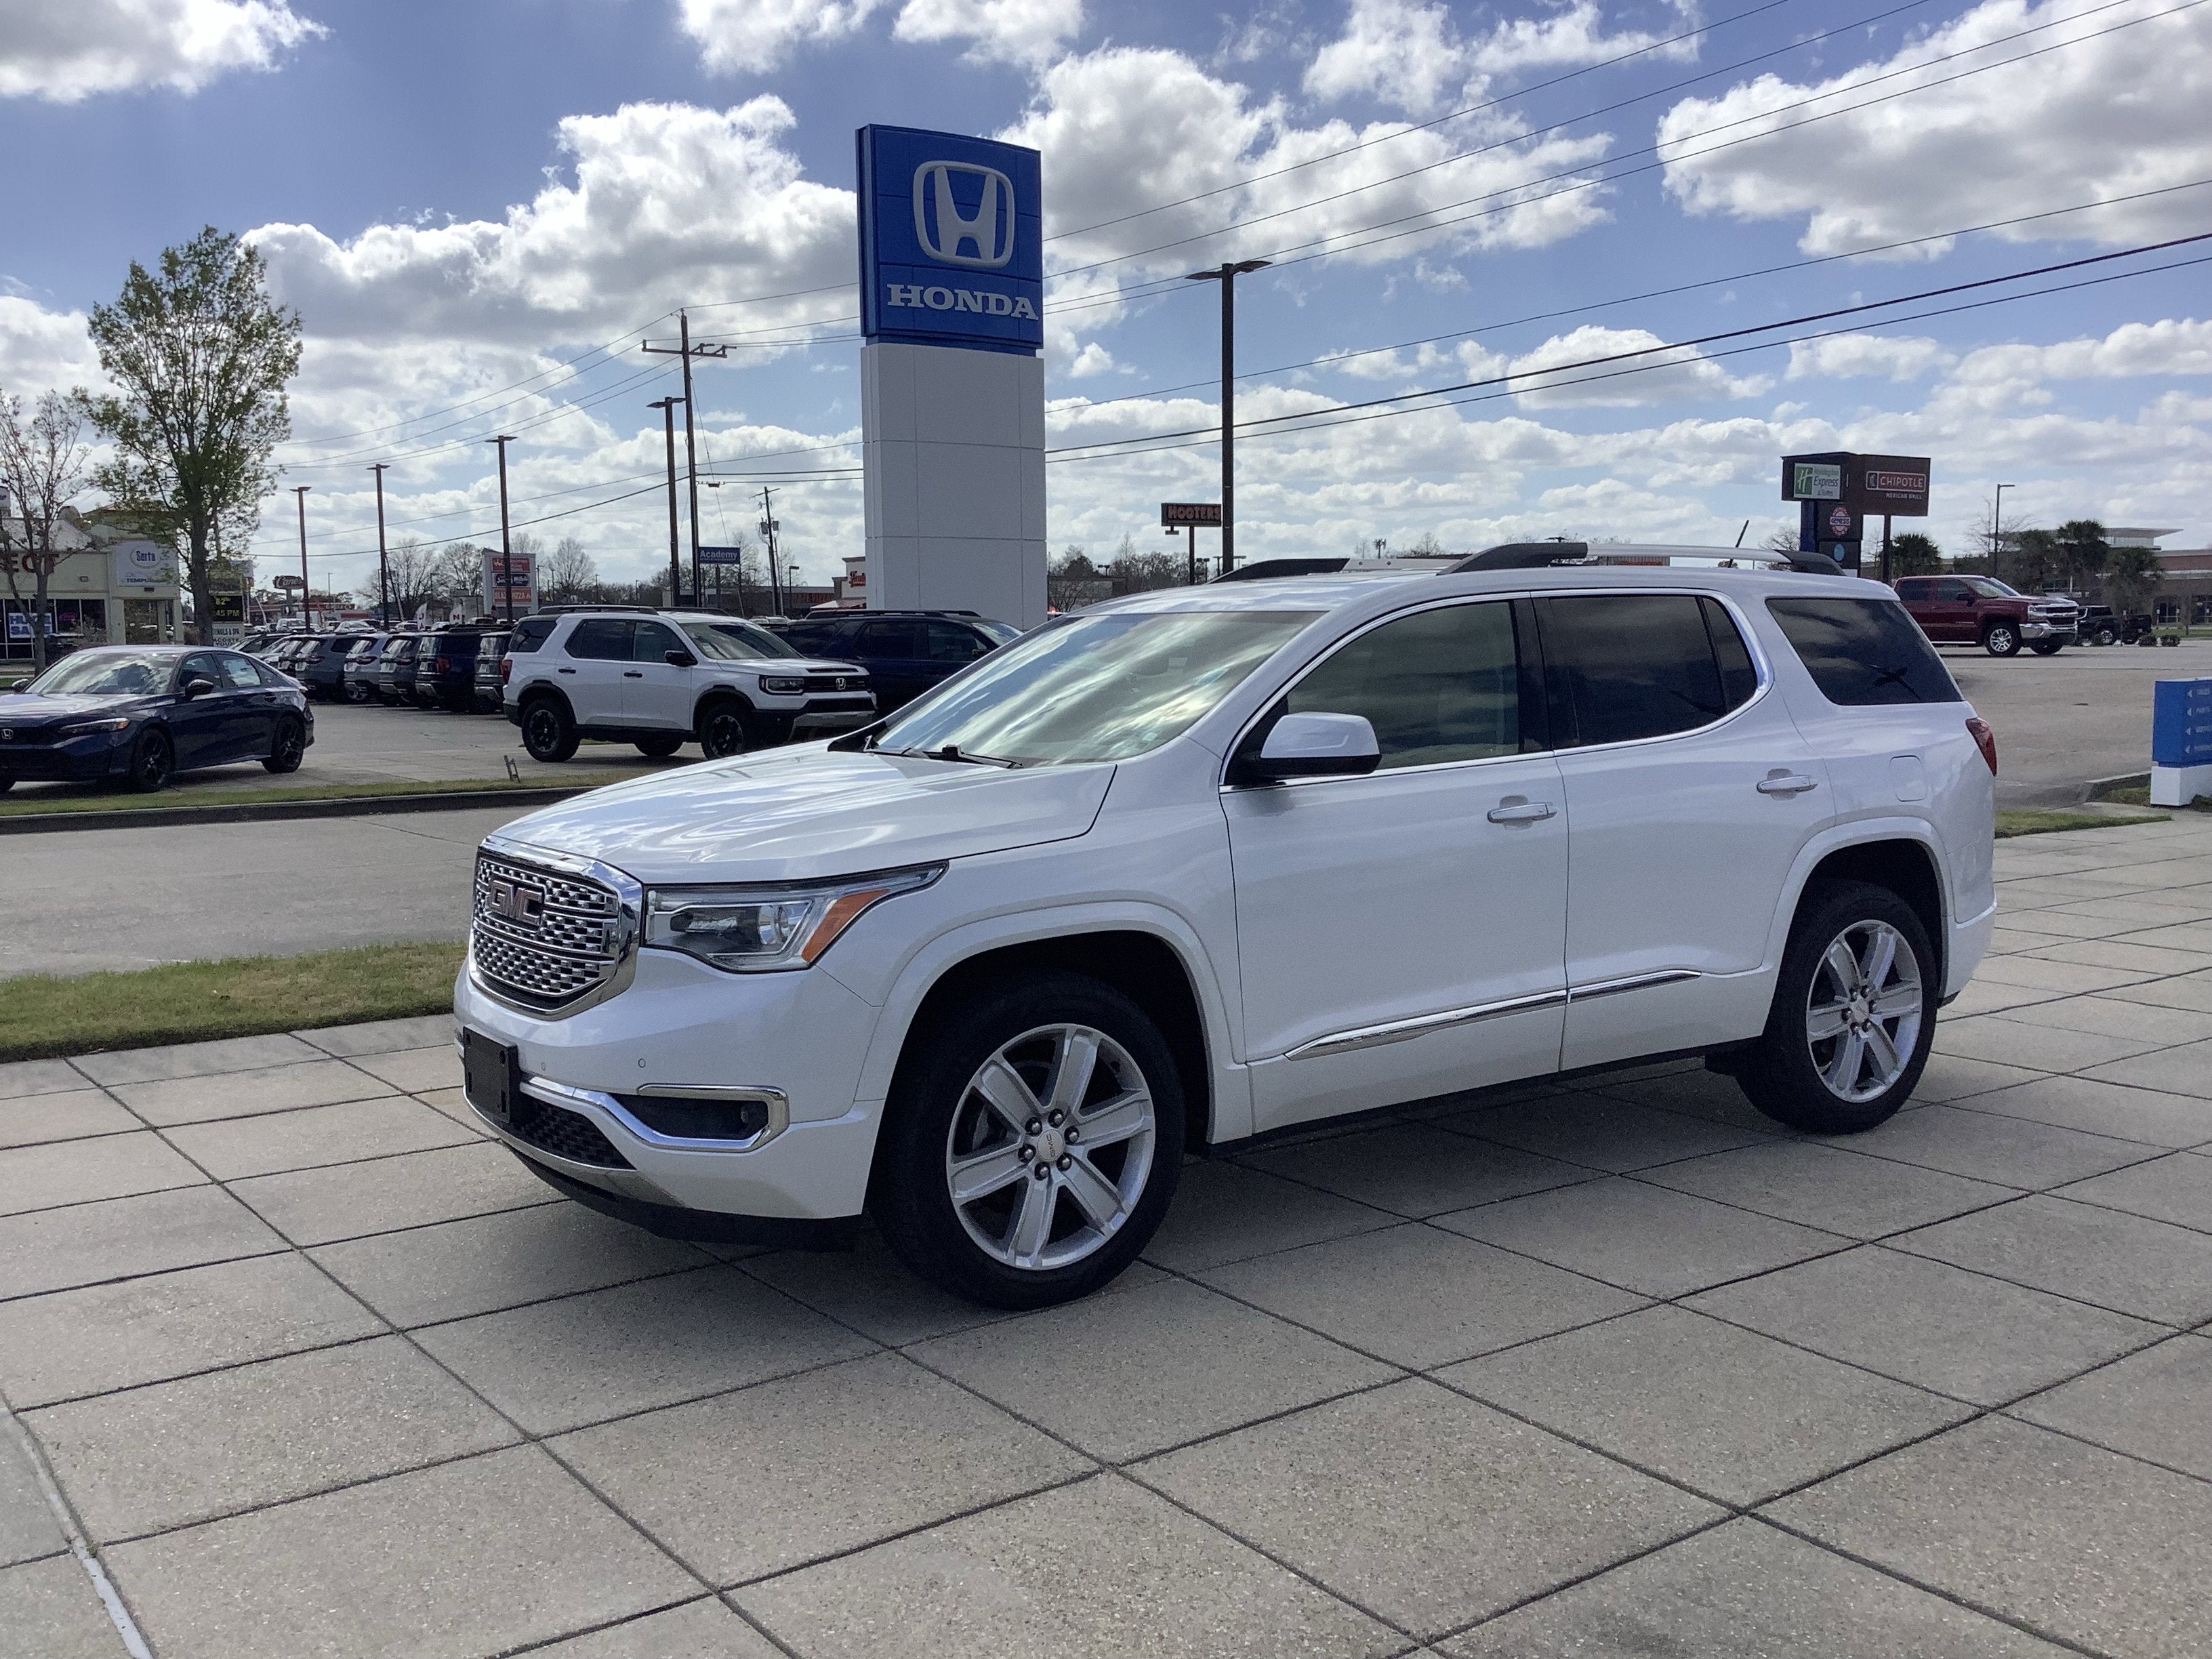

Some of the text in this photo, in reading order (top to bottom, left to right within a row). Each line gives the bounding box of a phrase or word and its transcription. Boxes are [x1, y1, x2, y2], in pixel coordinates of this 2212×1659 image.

[886, 283, 1039, 321] HONDA
[1814, 476, 1839, 487] Express
[1880, 476, 1923, 487] CHIPOTLE
[1168, 506, 1221, 520] HOOTERS
[136, 551, 155, 561] Serta
[700, 550, 737, 560] Academy
[489, 880, 542, 926] GMC
[1046, 1133, 1055, 1157] GMC
